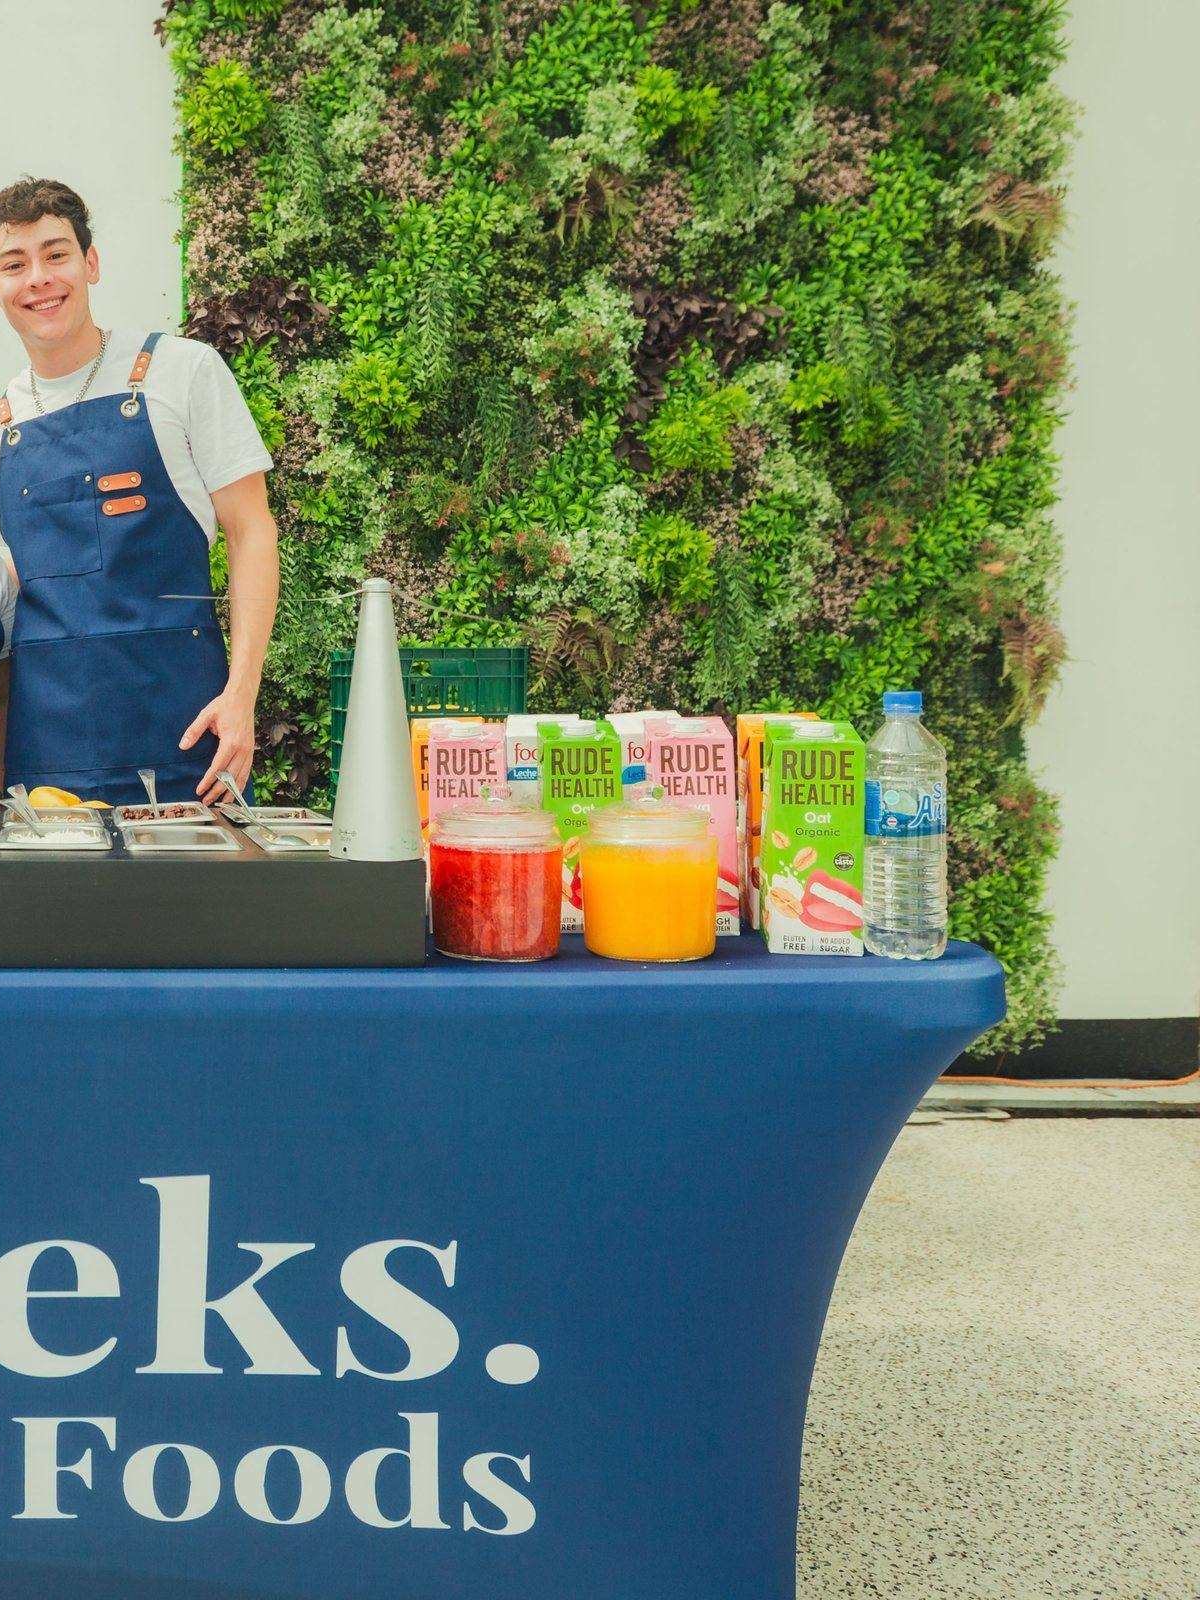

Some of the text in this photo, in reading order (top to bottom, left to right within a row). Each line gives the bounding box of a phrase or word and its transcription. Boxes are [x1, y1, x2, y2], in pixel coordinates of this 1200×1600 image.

[436, 748, 498, 776] RUDE
[551, 747, 614, 776] RUDE
[660, 744, 727, 773] RUDE
[782, 750, 855, 781] RUDE
[436, 778, 498, 798] HEAL
[551, 778, 615, 799] HEALTH
[661, 775, 728, 796] HEALTH
[781, 784, 855, 806] HEALTH
[563, 818, 588, 828] Orga
[804, 811, 833, 824] Oat
[795, 827, 841, 838] Organic
[783, 942, 806, 951] FREE
[819, 944, 850, 954] SUGAR
[12, 1413, 536, 1535] Foods
